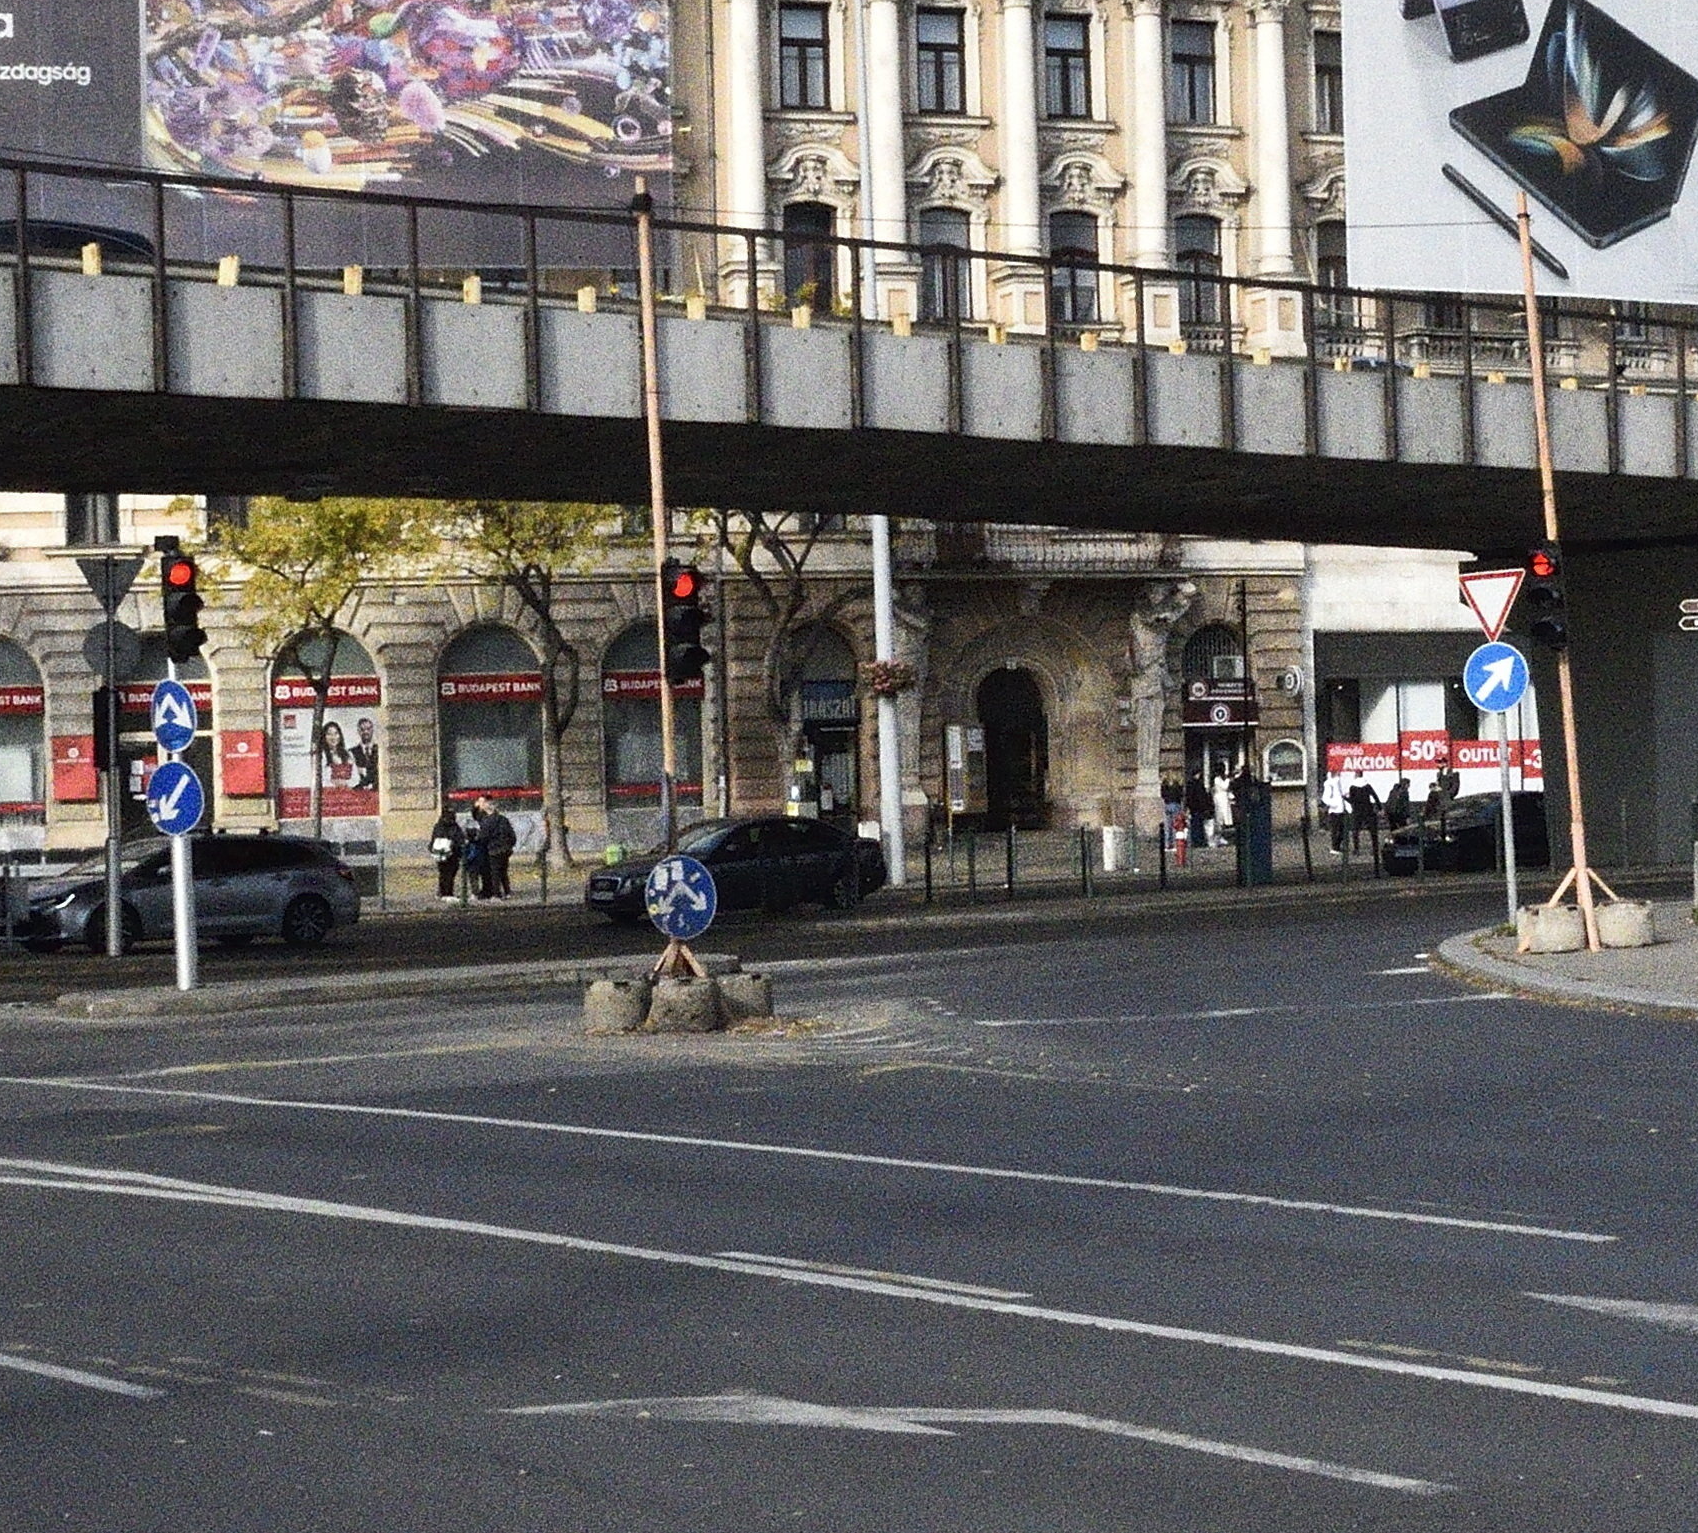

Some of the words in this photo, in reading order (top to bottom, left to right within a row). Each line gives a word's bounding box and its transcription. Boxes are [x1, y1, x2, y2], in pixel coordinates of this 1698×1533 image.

[292, 685, 348, 697] BUDEST
[350, 683, 378, 696] BANK
[458, 682, 511, 694] BUDAPEST
[513, 681, 542, 693] BANK
[620, 680, 662, 690] BUDAPE
[13, 694, 43, 706] BANK
[1402, 740, 1448, 761] -50%
[1343, 754, 1396, 769] AKCIÓK
